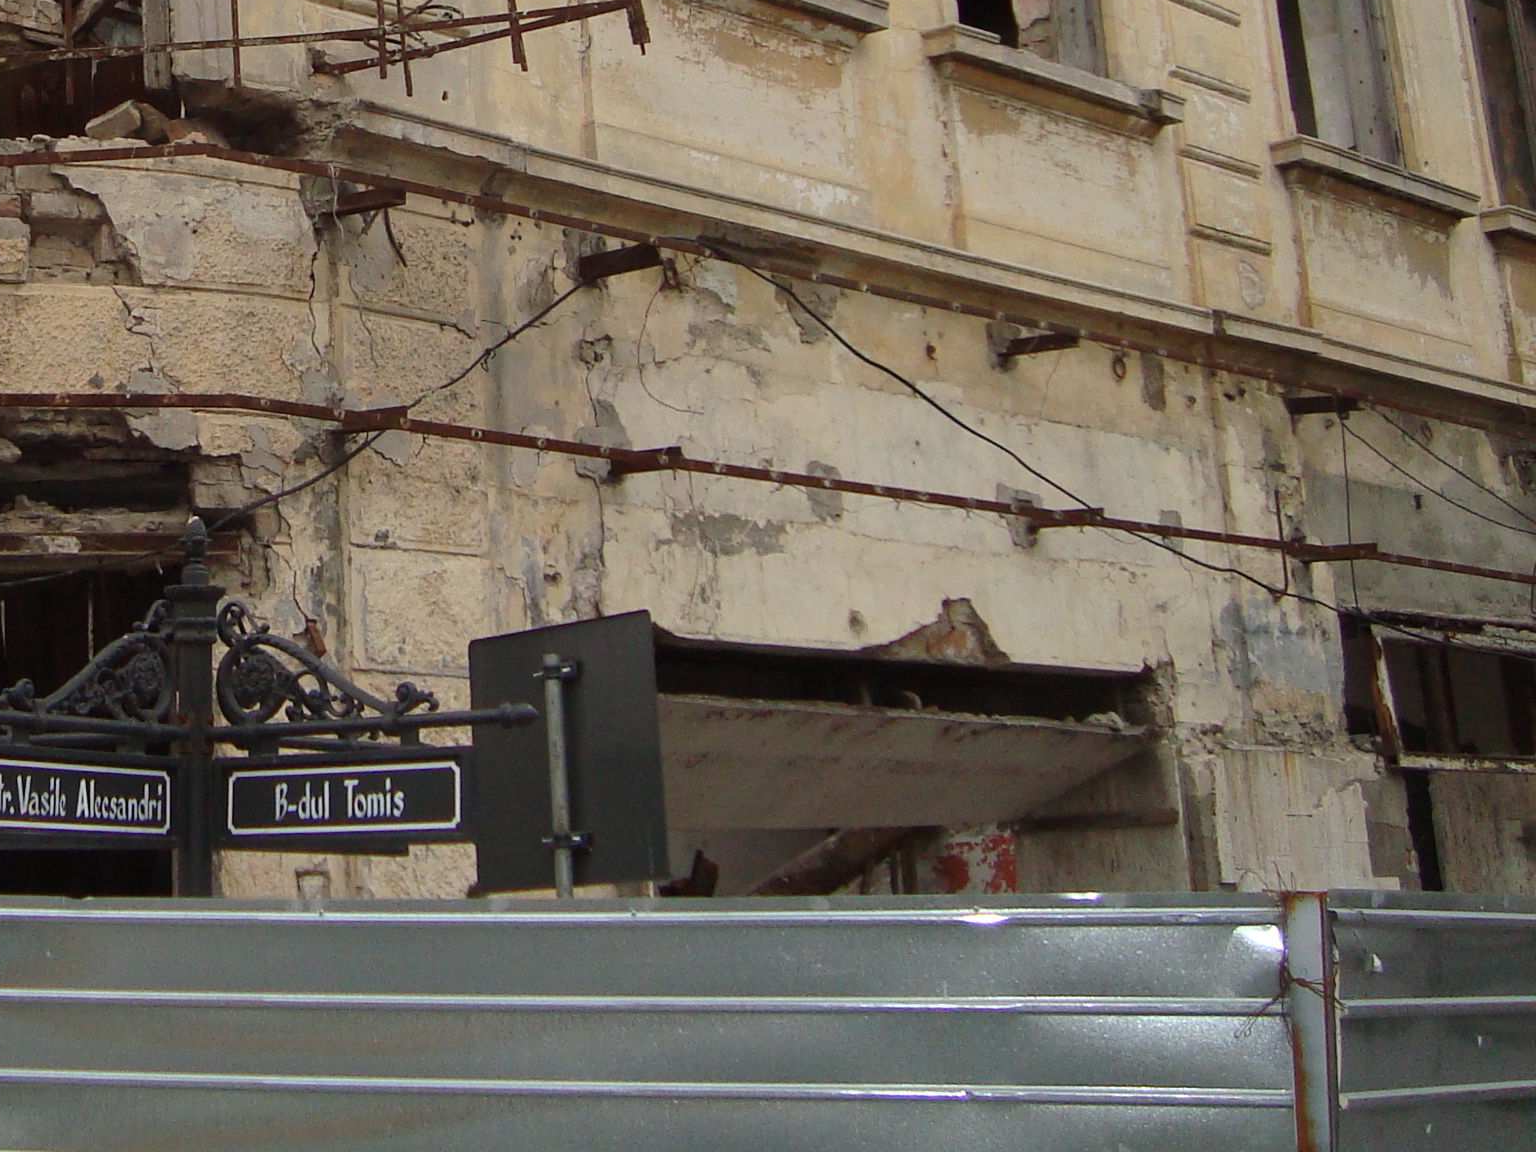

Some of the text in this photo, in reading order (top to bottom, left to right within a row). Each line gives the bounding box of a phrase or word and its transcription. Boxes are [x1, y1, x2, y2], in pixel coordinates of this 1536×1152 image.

[16, 774, 66, 817] Vasile
[76, 778, 163, 822] Alecsandri
[274, 777, 405, 822] B-dul Tomis
